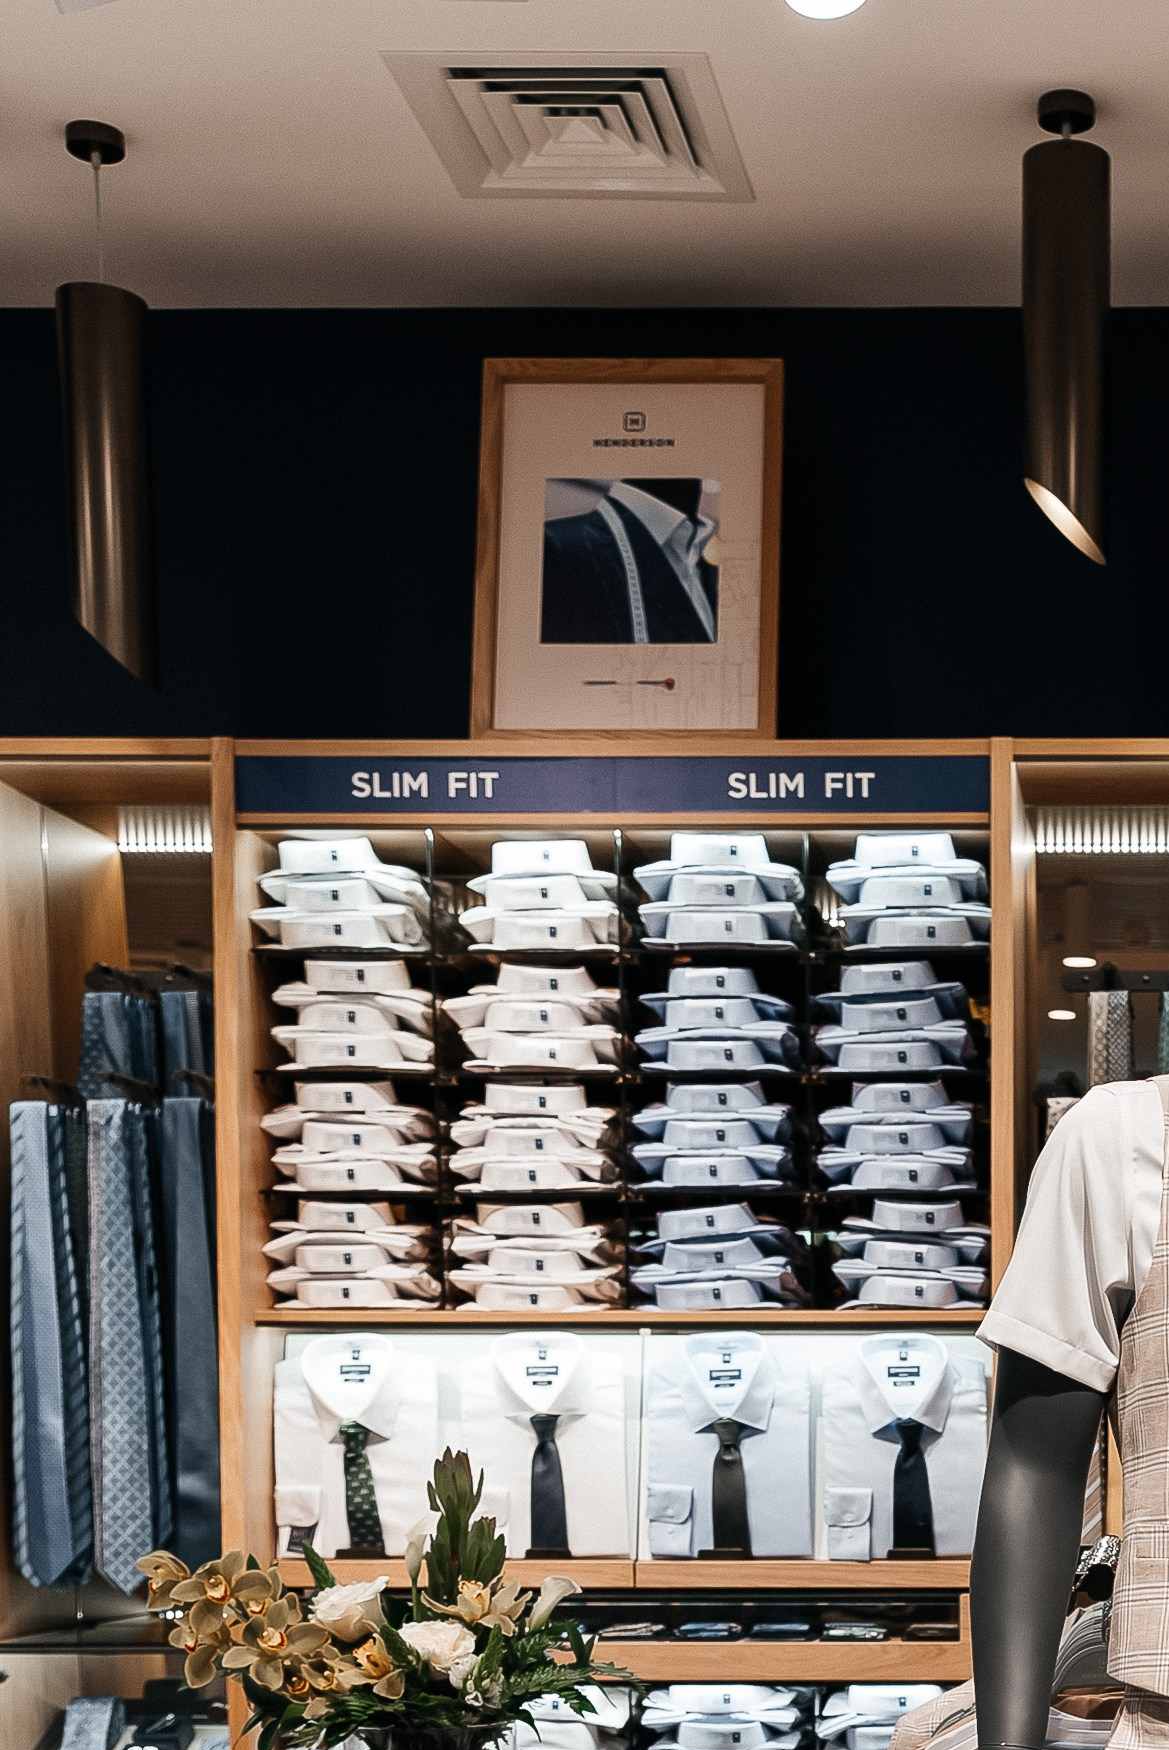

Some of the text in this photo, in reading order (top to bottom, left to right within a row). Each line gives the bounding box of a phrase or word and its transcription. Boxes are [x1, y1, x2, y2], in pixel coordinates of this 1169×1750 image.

[351, 771, 500, 799] SLIM FIT
[727, 772, 876, 799] SLIM FIT
